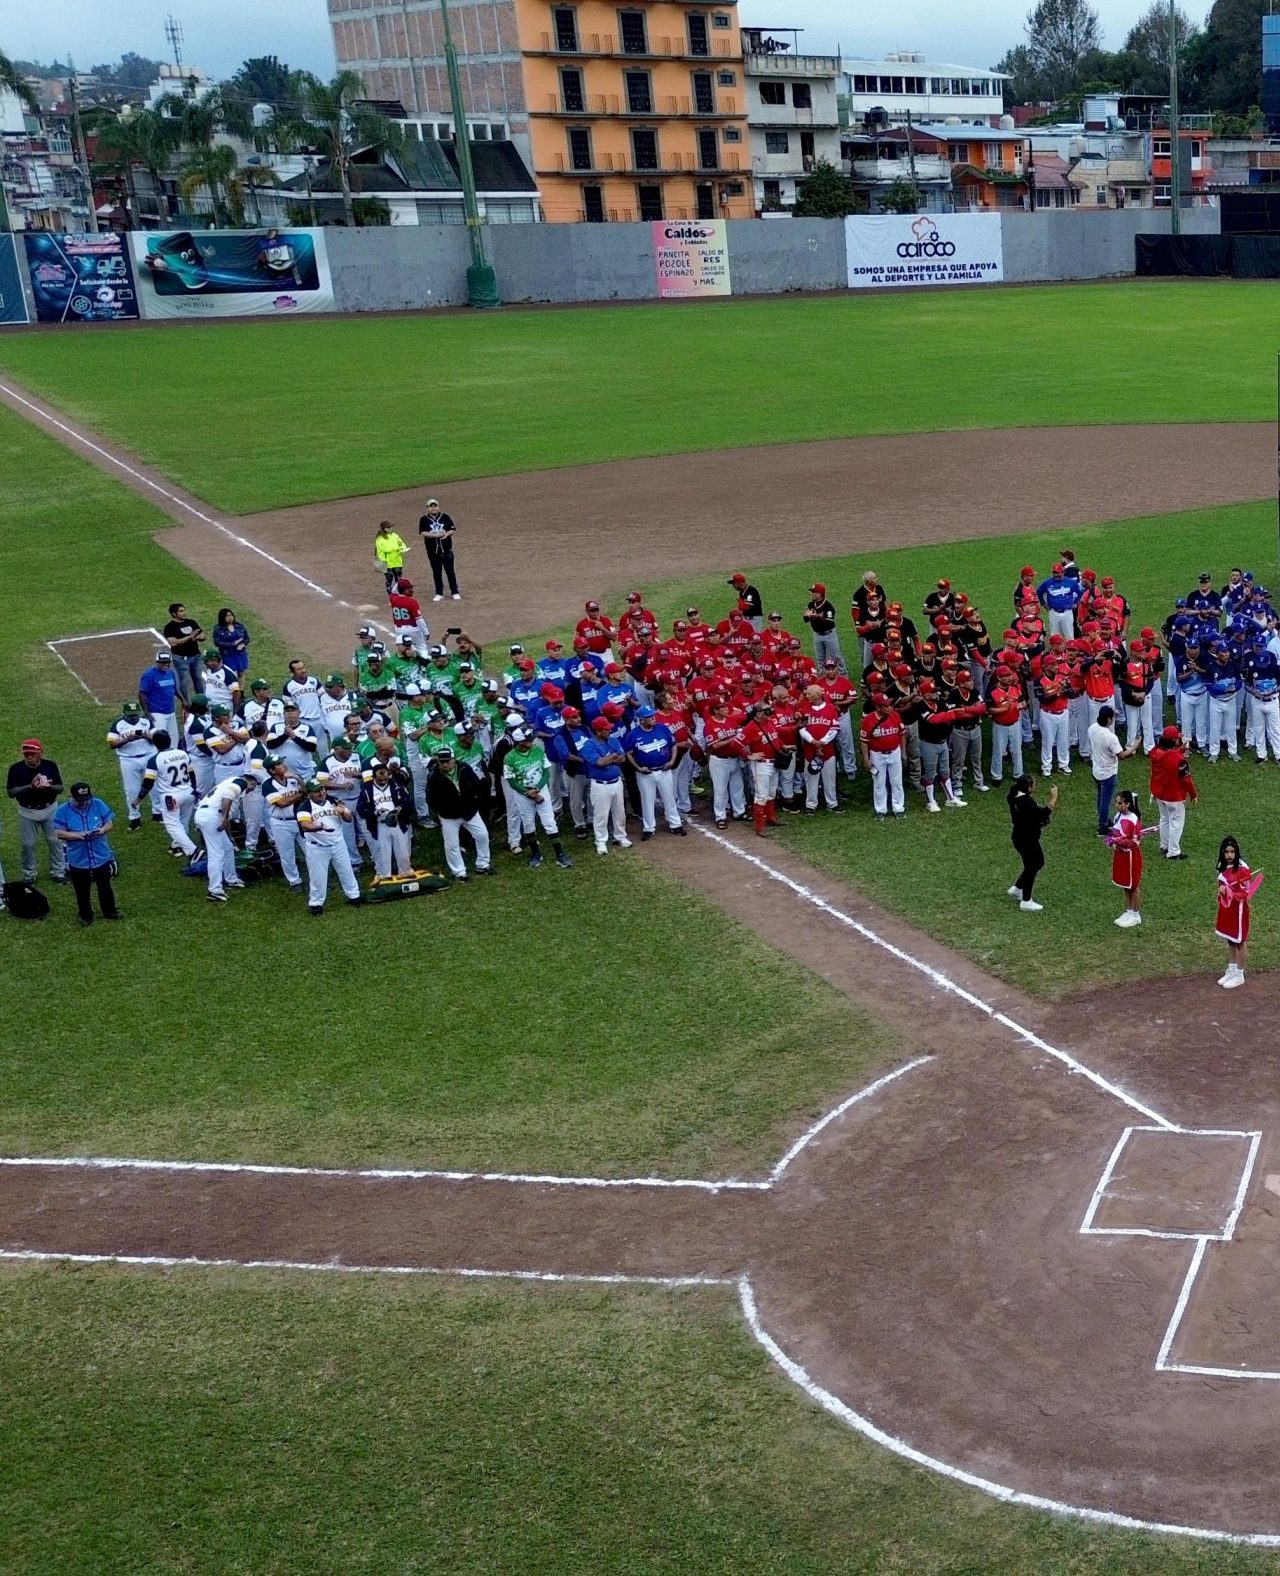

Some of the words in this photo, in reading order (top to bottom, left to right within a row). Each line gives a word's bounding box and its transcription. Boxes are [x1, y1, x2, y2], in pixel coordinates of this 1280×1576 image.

[665, 228, 706, 239] Caldos
[660, 260, 691, 268] POZOLE
[854, 267, 885, 275] SOMOS
[887, 266, 905, 274] UNA
[907, 264, 948, 273] EMPRESA
[950, 263, 967, 271] QUE
[967, 262, 998, 271] APOYA
[661, 269, 694, 277] ESPINAZO
[871, 275, 883, 283] AL
[885, 273, 925, 282] DEPORTE
[927, 273, 933, 281] Y
[935, 272, 946, 280] LA
[948, 271, 983, 280] FAMILIA
[393, 607, 410, 620] 96
[325, 704, 351, 714] YUCATA
[167, 762, 190, 788] 23
